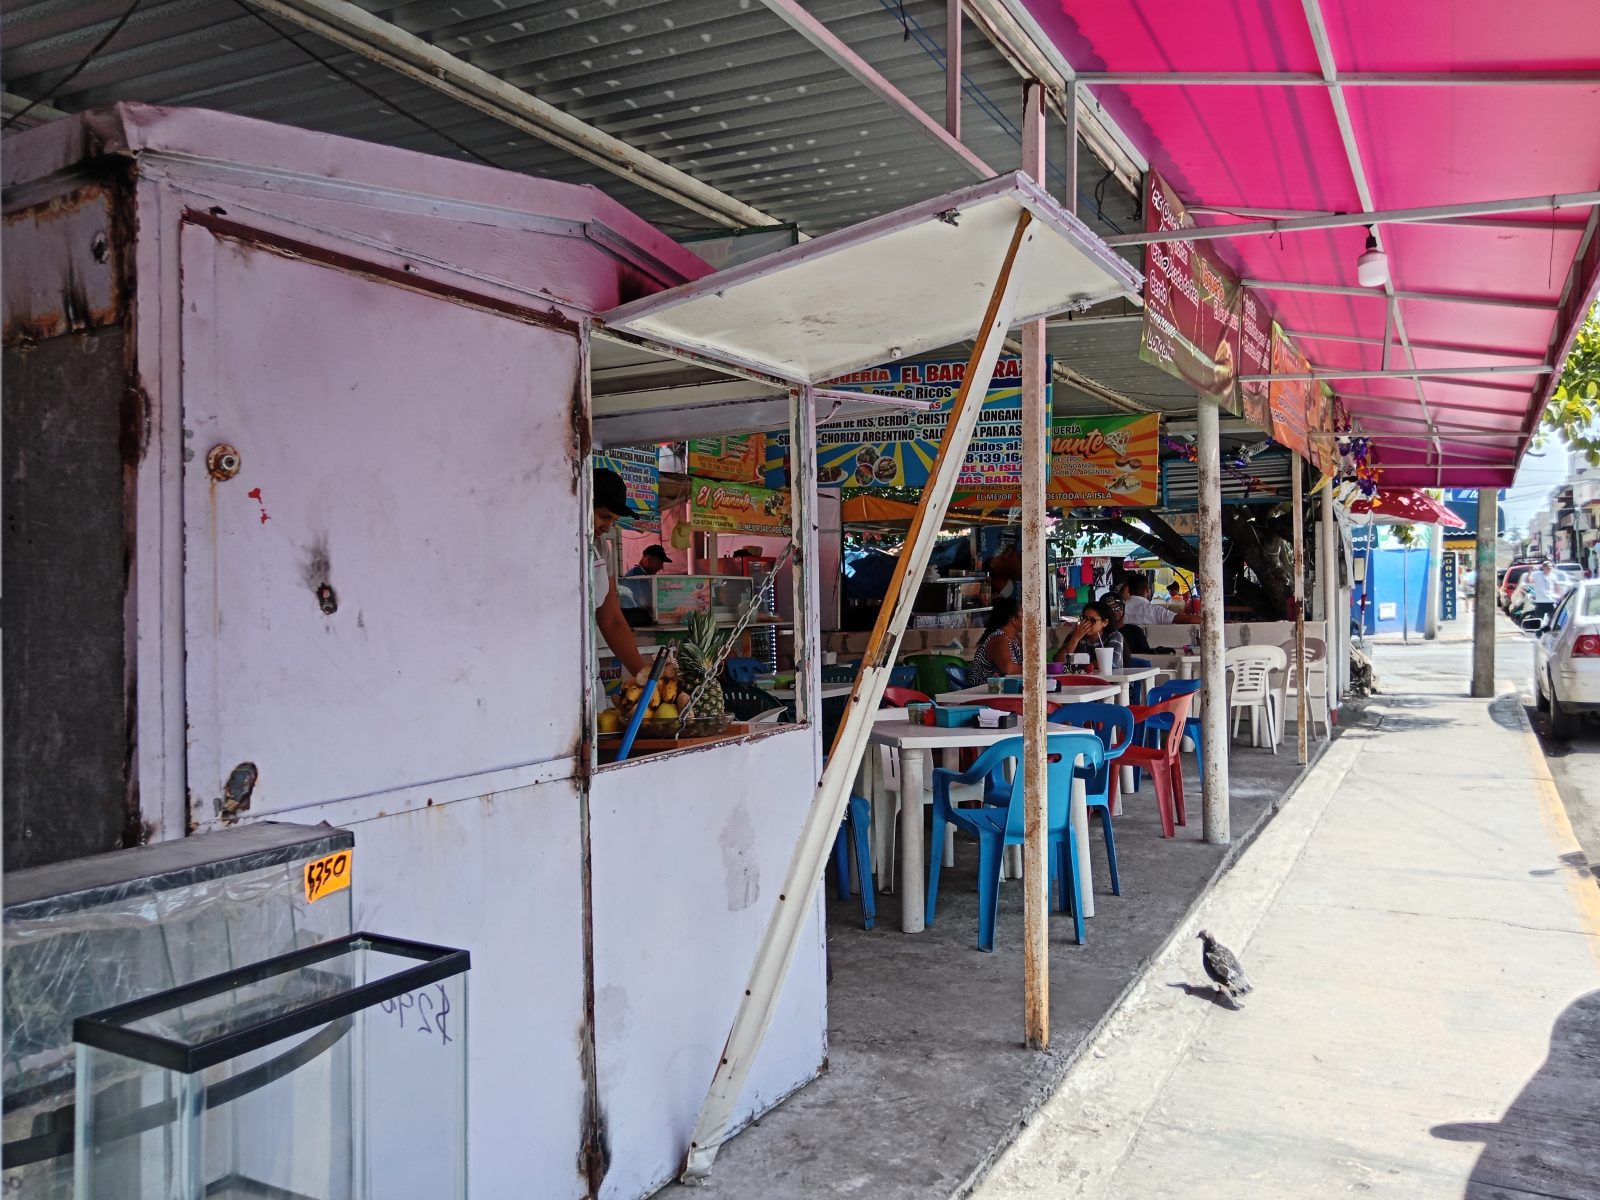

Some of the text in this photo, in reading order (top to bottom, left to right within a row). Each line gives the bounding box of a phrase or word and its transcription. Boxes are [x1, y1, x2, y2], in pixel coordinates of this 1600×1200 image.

[901, 367, 920, 384] EL
[916, 387, 951, 399] Ricos
[878, 415, 909, 426] CERDO
[863, 430, 915, 442] ARGENTINO
[980, 426, 1005, 437] PARA
[978, 453, 1000, 463] 139
[1094, 491, 1112, 499] ISLA
